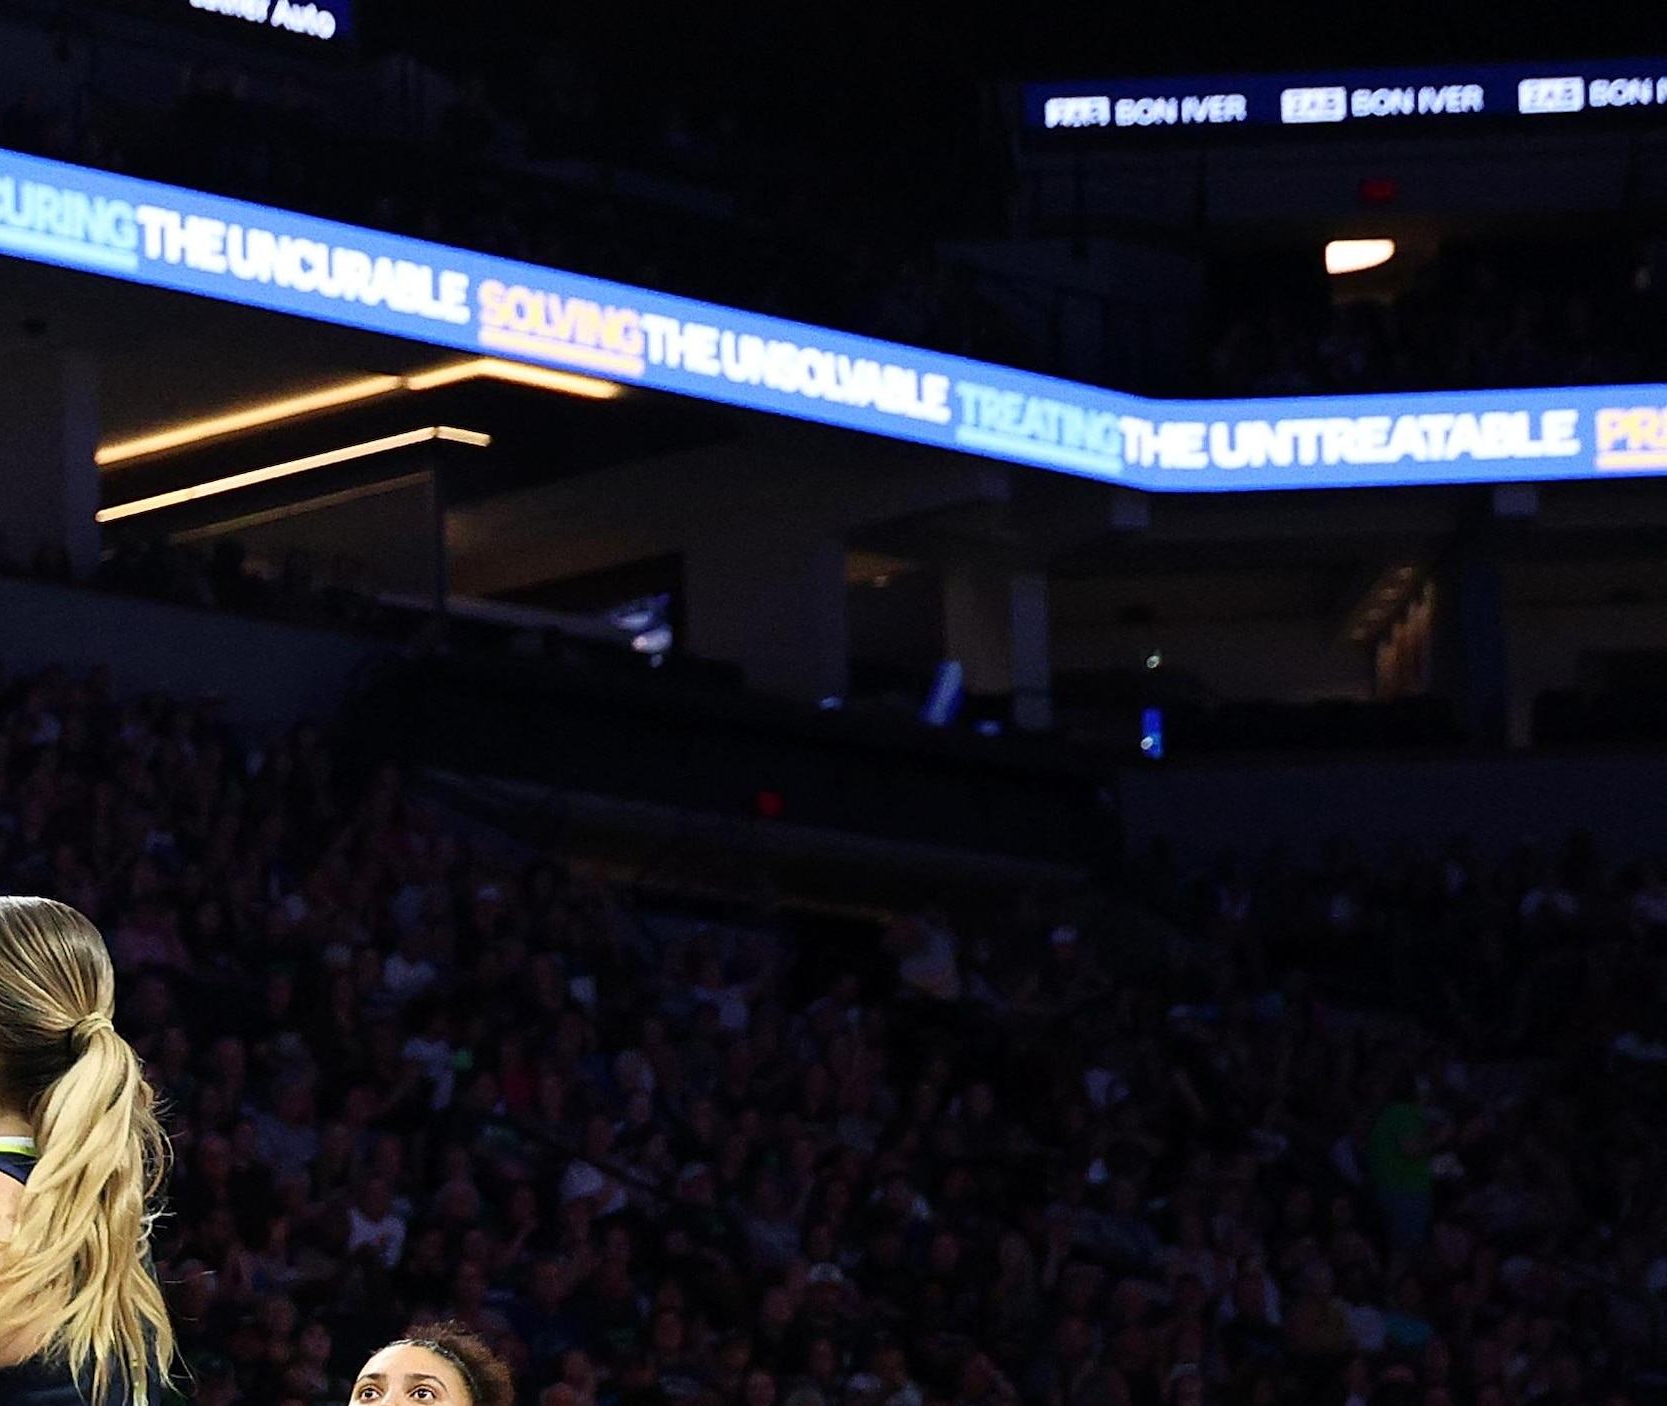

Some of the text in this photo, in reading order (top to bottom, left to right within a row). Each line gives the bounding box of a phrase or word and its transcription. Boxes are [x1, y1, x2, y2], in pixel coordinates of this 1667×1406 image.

[1352, 86, 1415, 116] BON
[1418, 84, 1483, 114] IVER
[136, 205, 228, 274] THE
[228, 224, 469, 325] UNCURABLE
[479, 278, 951, 424] SOLVING THE UNSOLVABLE
[957, 381, 1580, 470] TREATING THE UNTREATABLE
